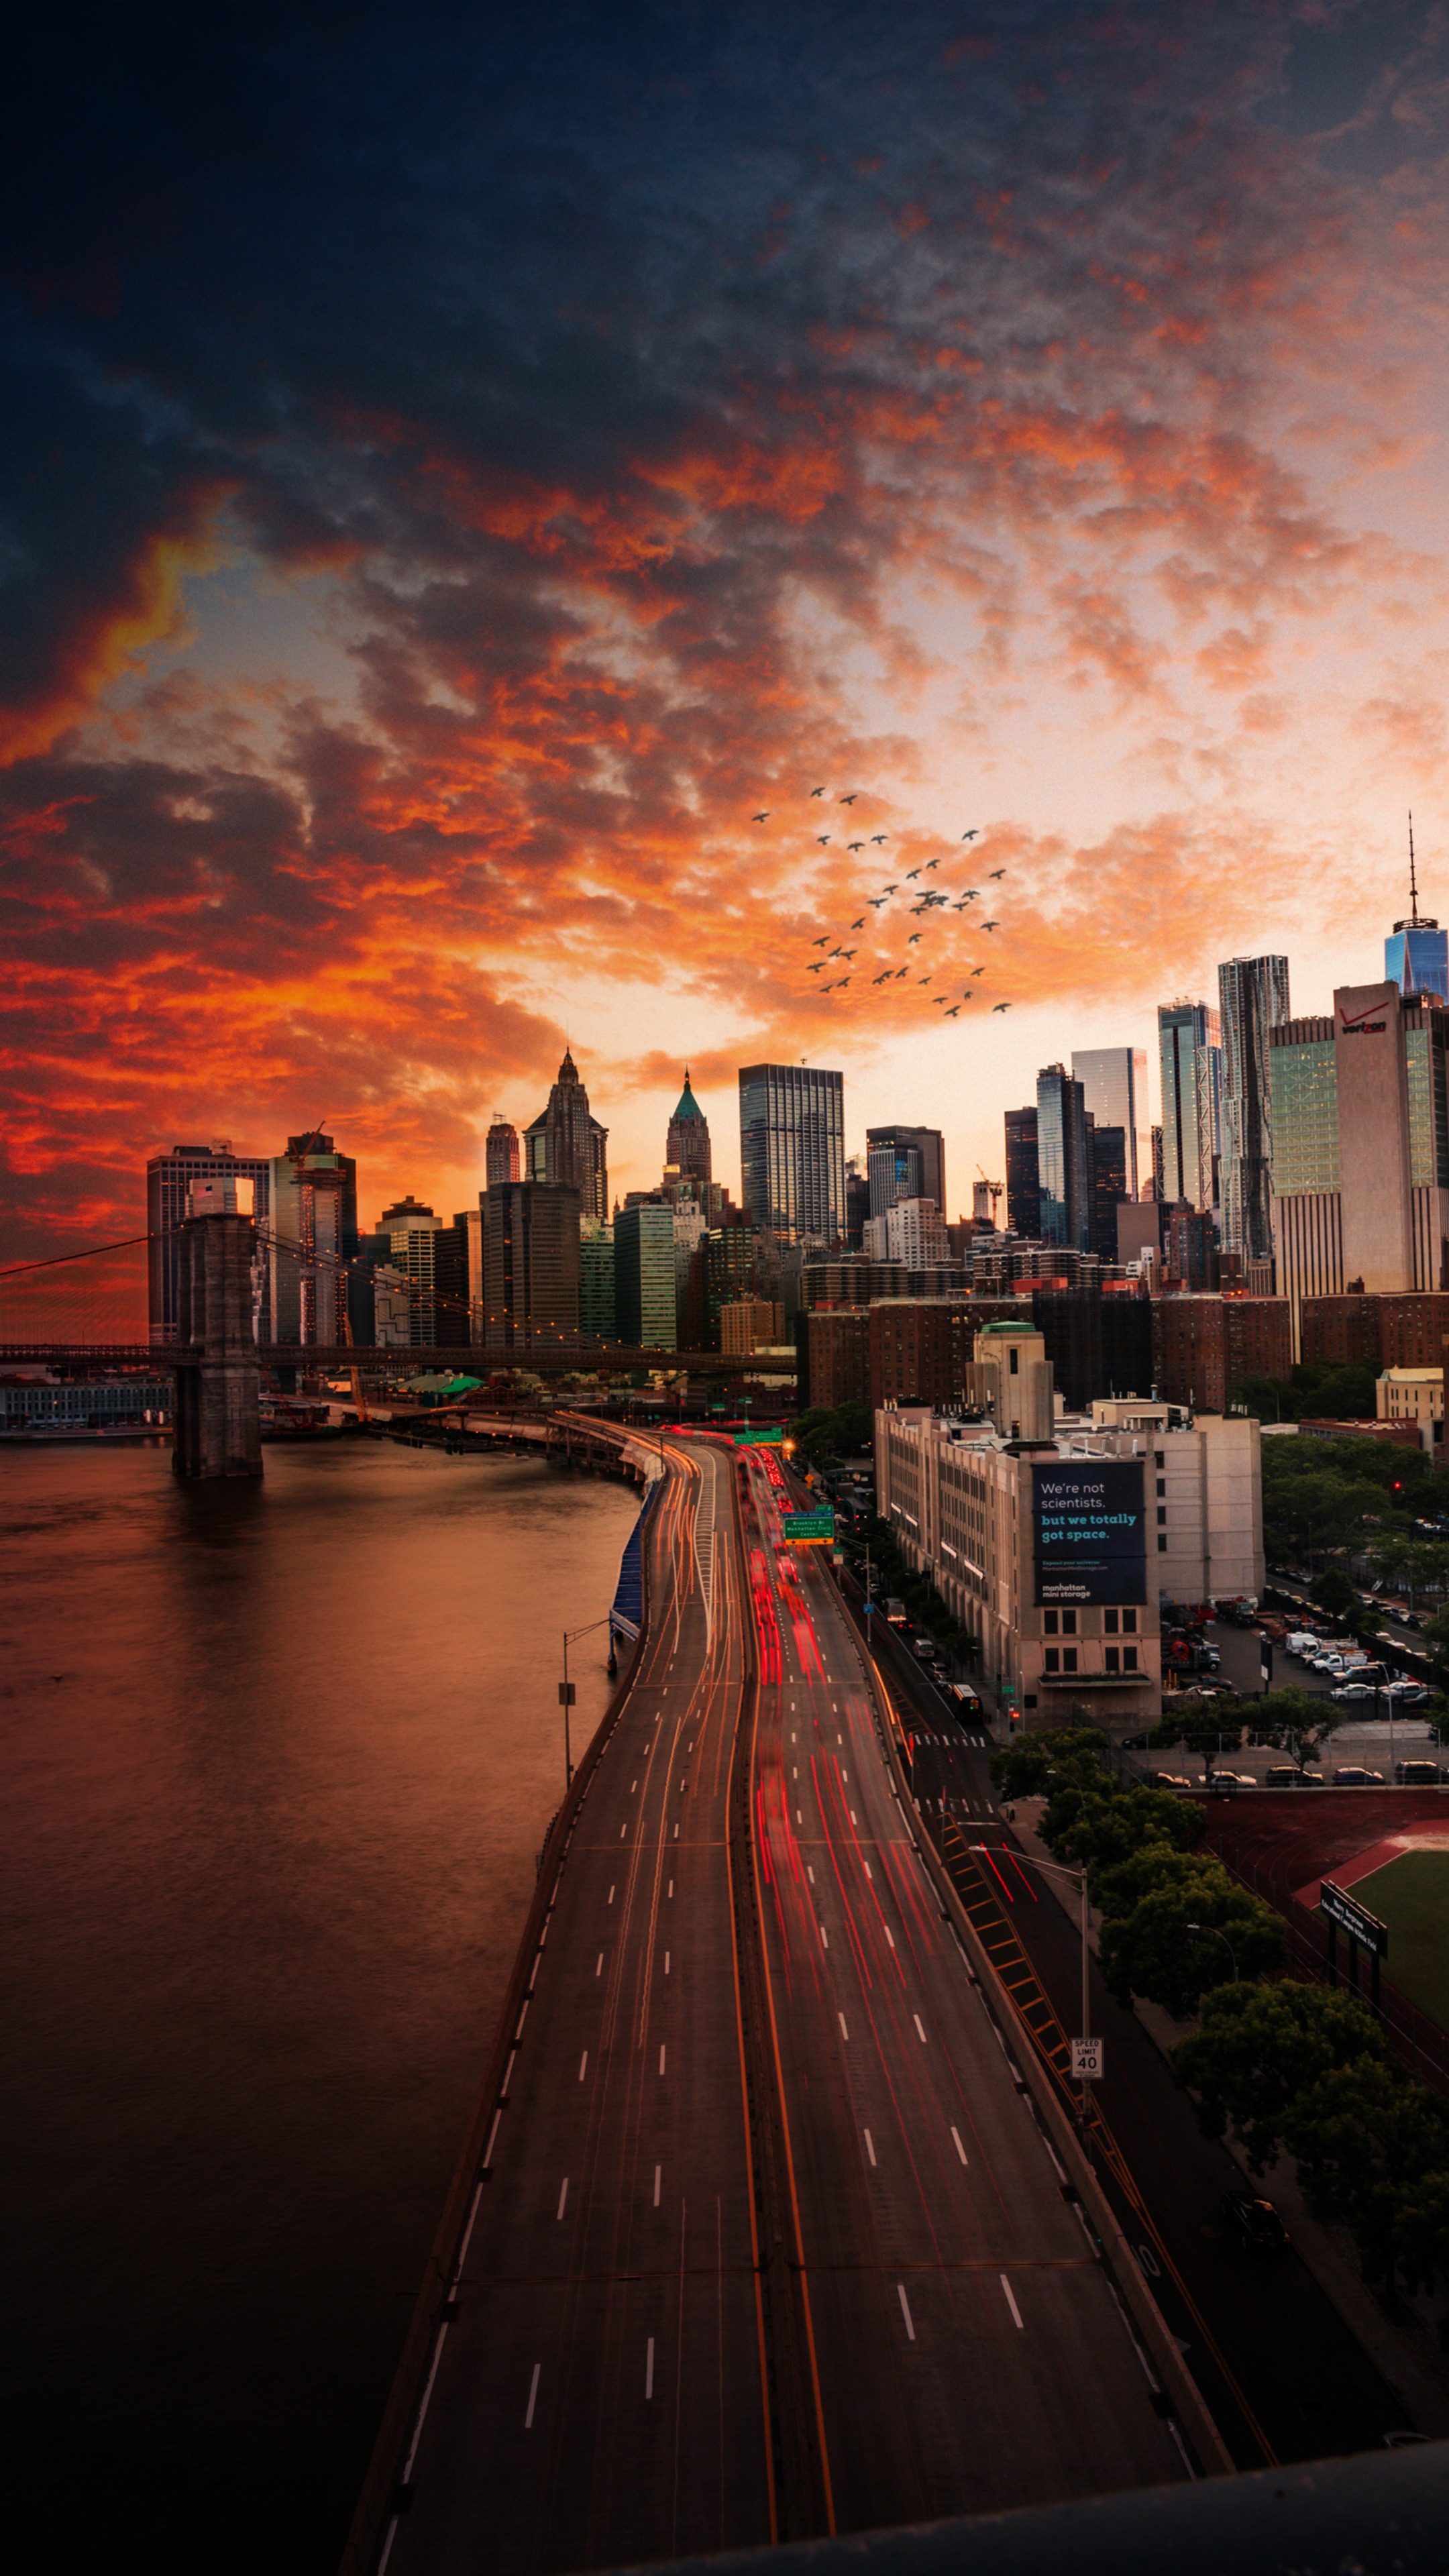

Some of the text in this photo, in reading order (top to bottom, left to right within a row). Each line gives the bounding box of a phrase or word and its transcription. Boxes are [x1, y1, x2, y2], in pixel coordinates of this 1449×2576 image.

[1342, 1022, 1387, 1034] verizon
[1083, 1483, 1105, 1493] not
[1041, 1515, 1065, 1525] but
[1089, 1513, 1136, 1526] totally
[1042, 1530, 1110, 1543] got space.
[1042, 1582, 1085, 1591] manhattan
[1077, 2057, 1096, 2069] 40
